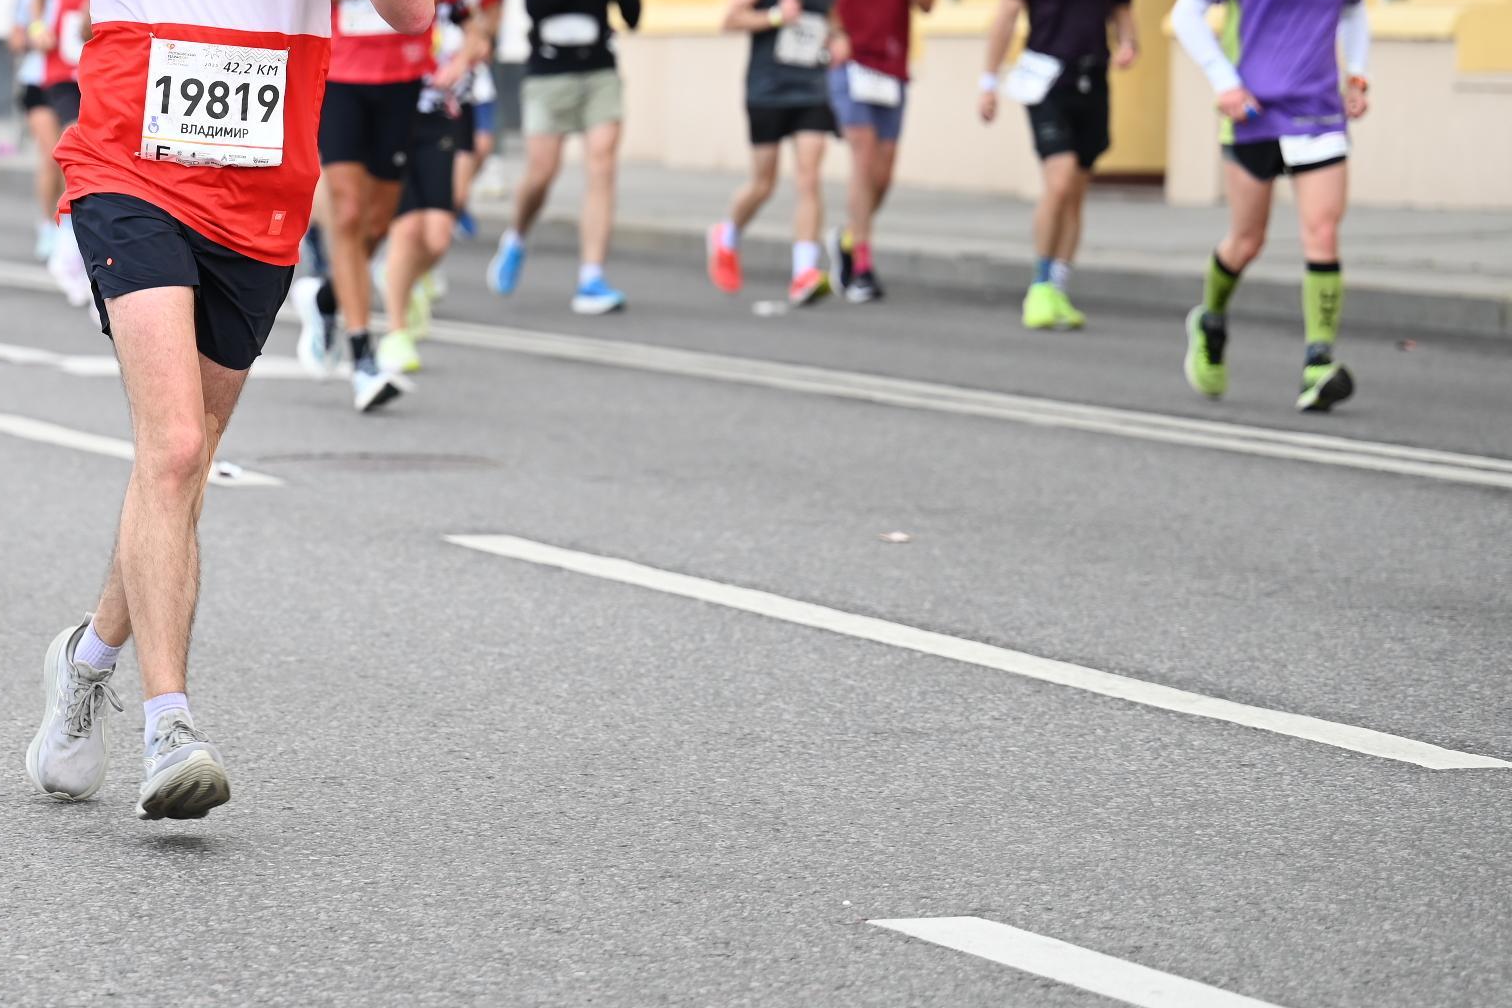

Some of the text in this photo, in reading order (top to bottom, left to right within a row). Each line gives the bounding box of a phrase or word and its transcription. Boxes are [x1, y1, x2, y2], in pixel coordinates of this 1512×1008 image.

[223, 61, 253, 75] 42,2
[155, 75, 280, 123] 19819
[180, 123, 249, 138] ВЛАДИМИР
